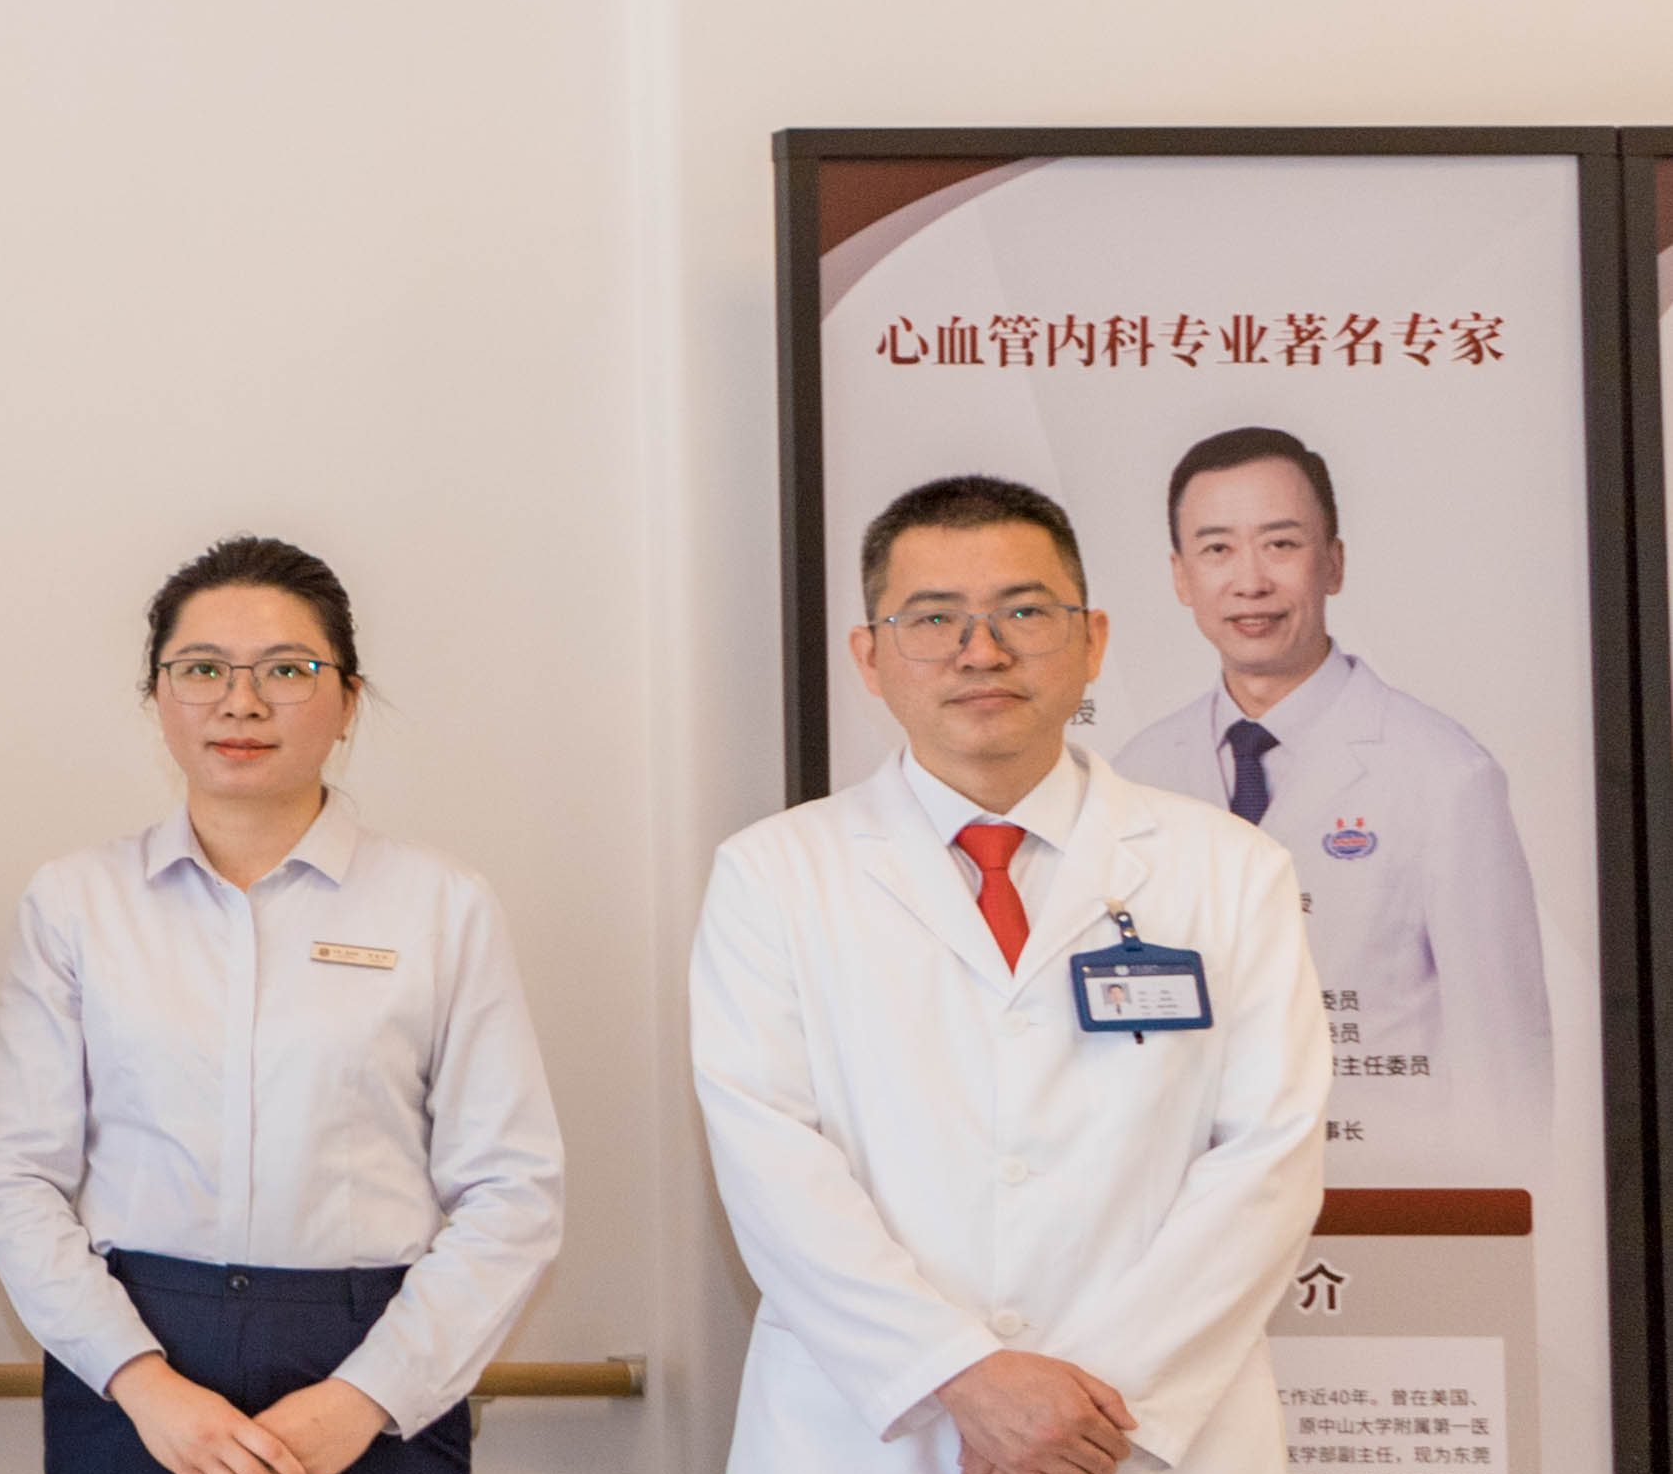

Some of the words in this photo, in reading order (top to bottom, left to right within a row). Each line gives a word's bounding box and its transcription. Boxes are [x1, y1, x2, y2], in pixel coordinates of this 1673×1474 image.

[876, 312, 1505, 367] 心血管内科专业著名专家
[1333, 1055, 1430, 1076] 主任委员
[1297, 1263, 1345, 1311] 介
